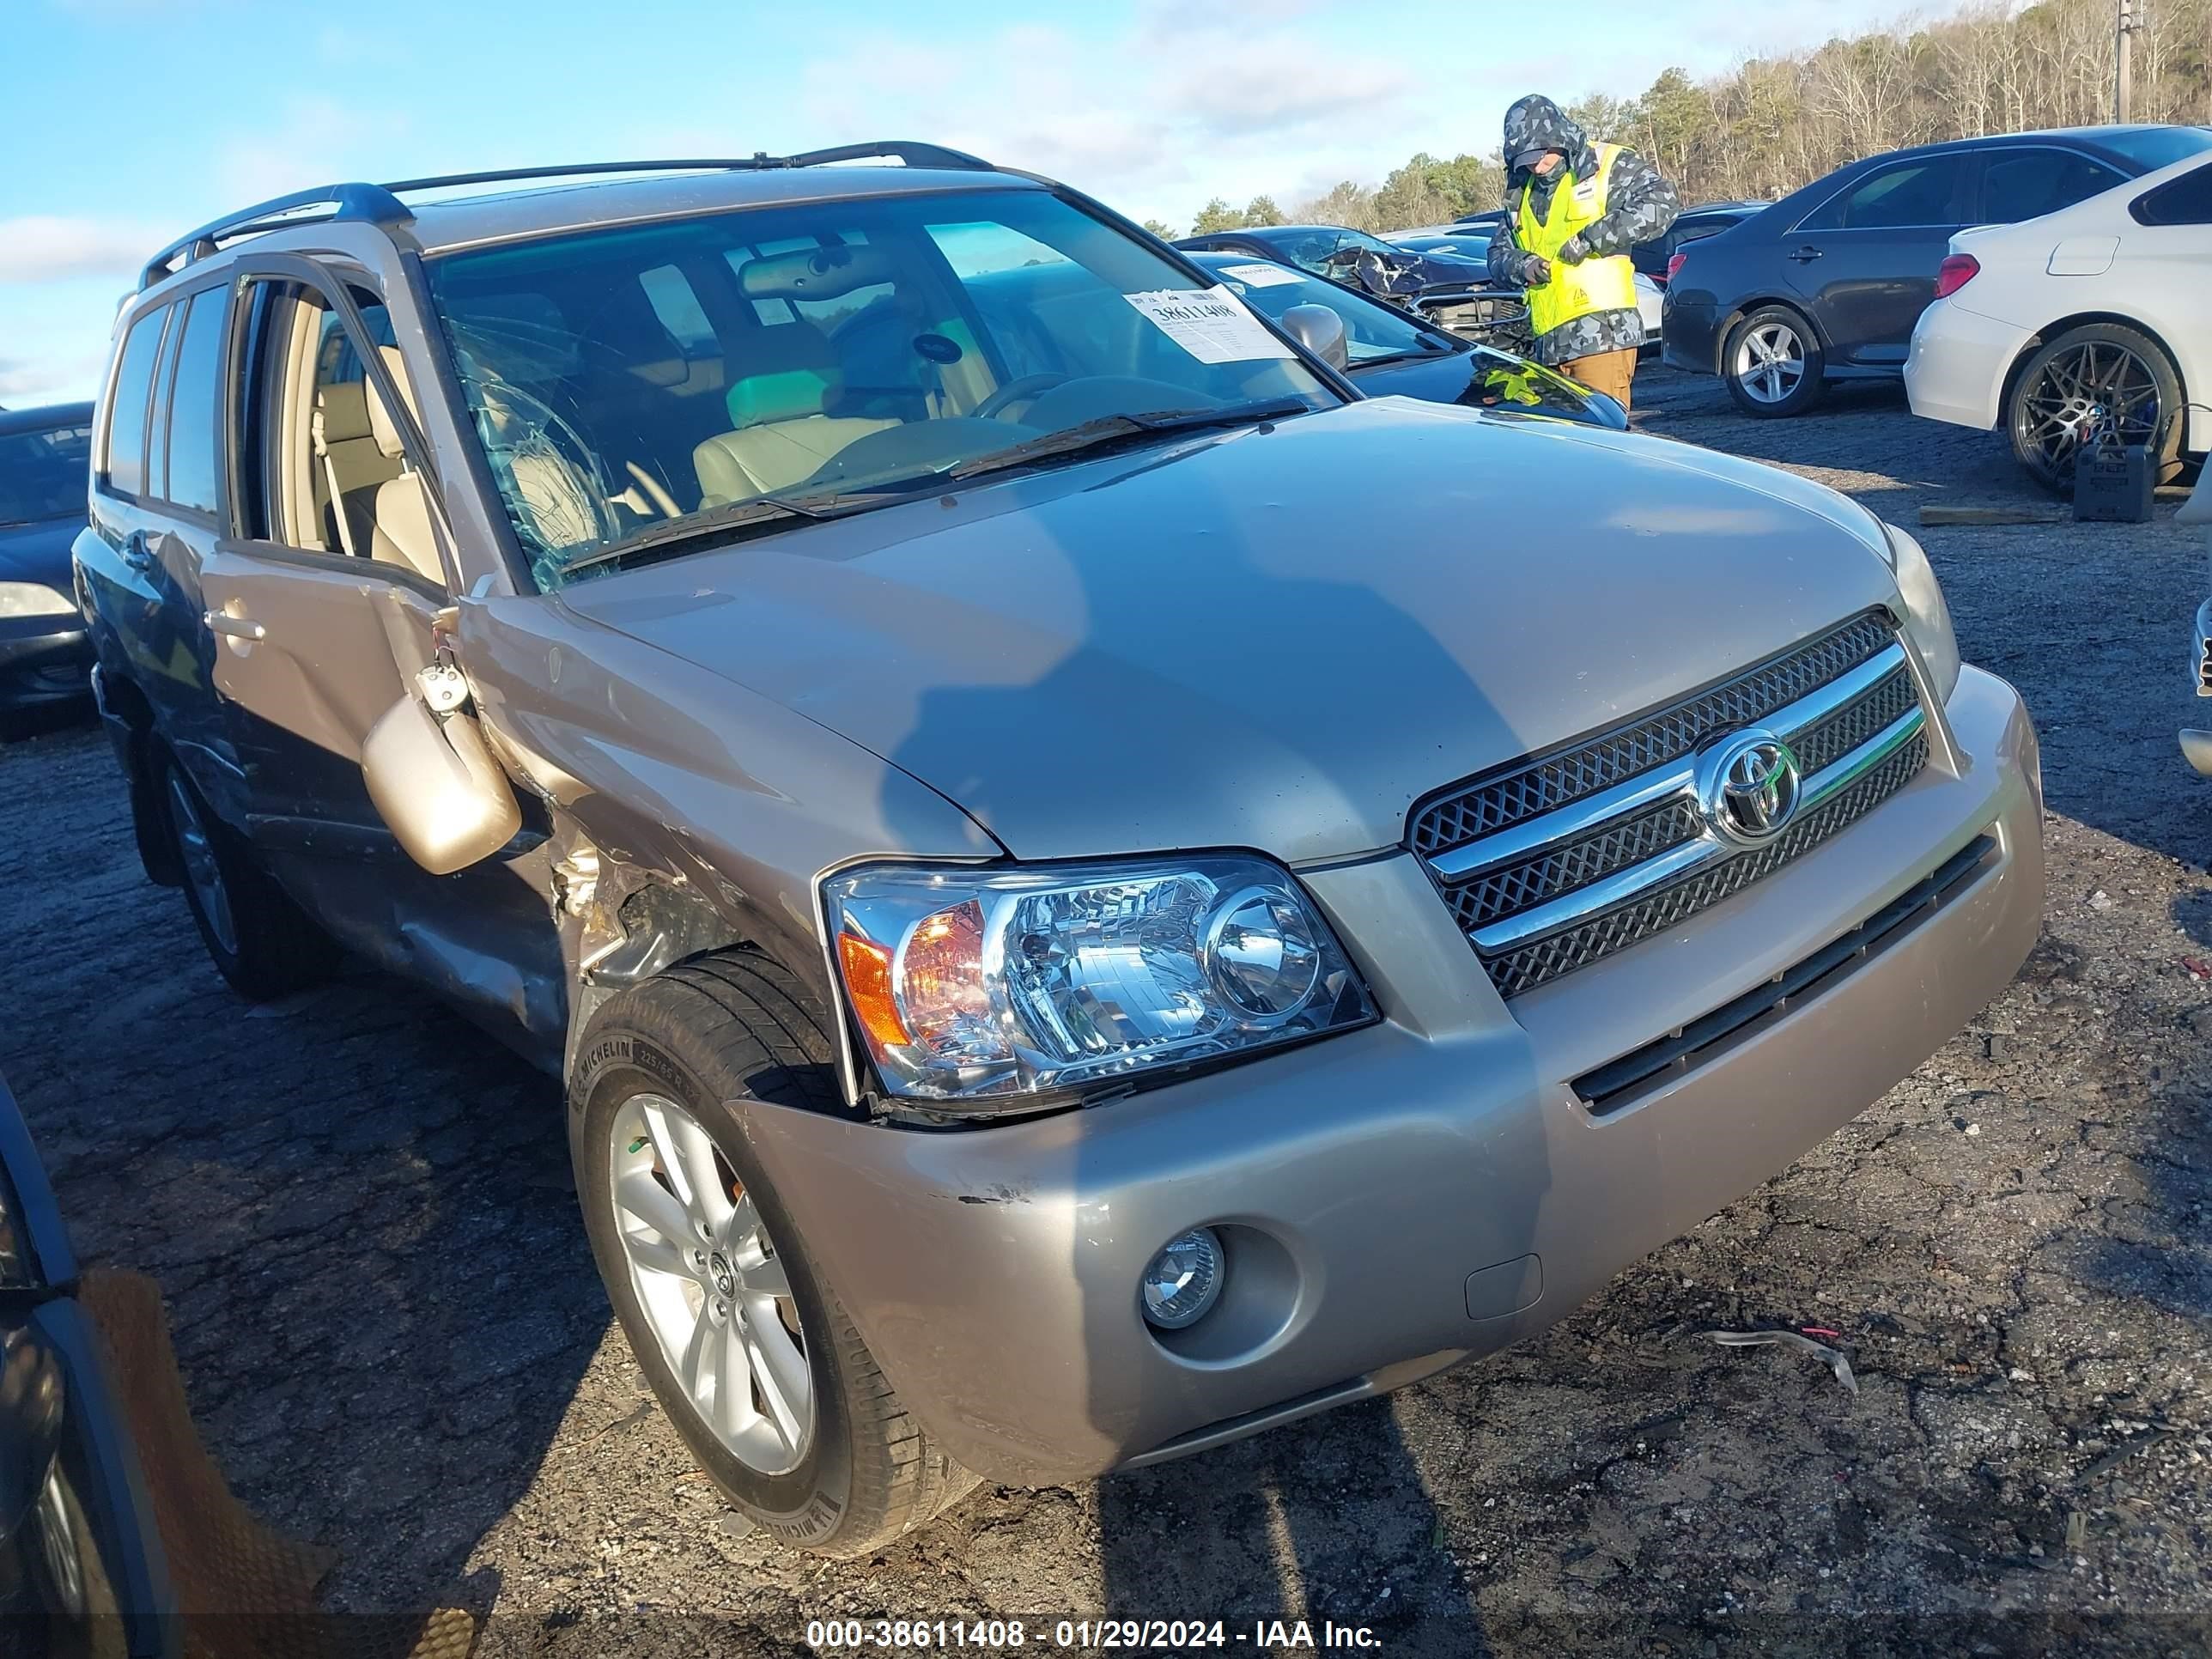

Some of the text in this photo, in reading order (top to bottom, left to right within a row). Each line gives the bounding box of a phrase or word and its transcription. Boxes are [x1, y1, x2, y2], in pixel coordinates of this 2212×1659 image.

[1152, 304, 1237, 322] 38611408
[580, 1041, 630, 1080] MICHELIN
[640, 1050, 673, 1079] 225/65
